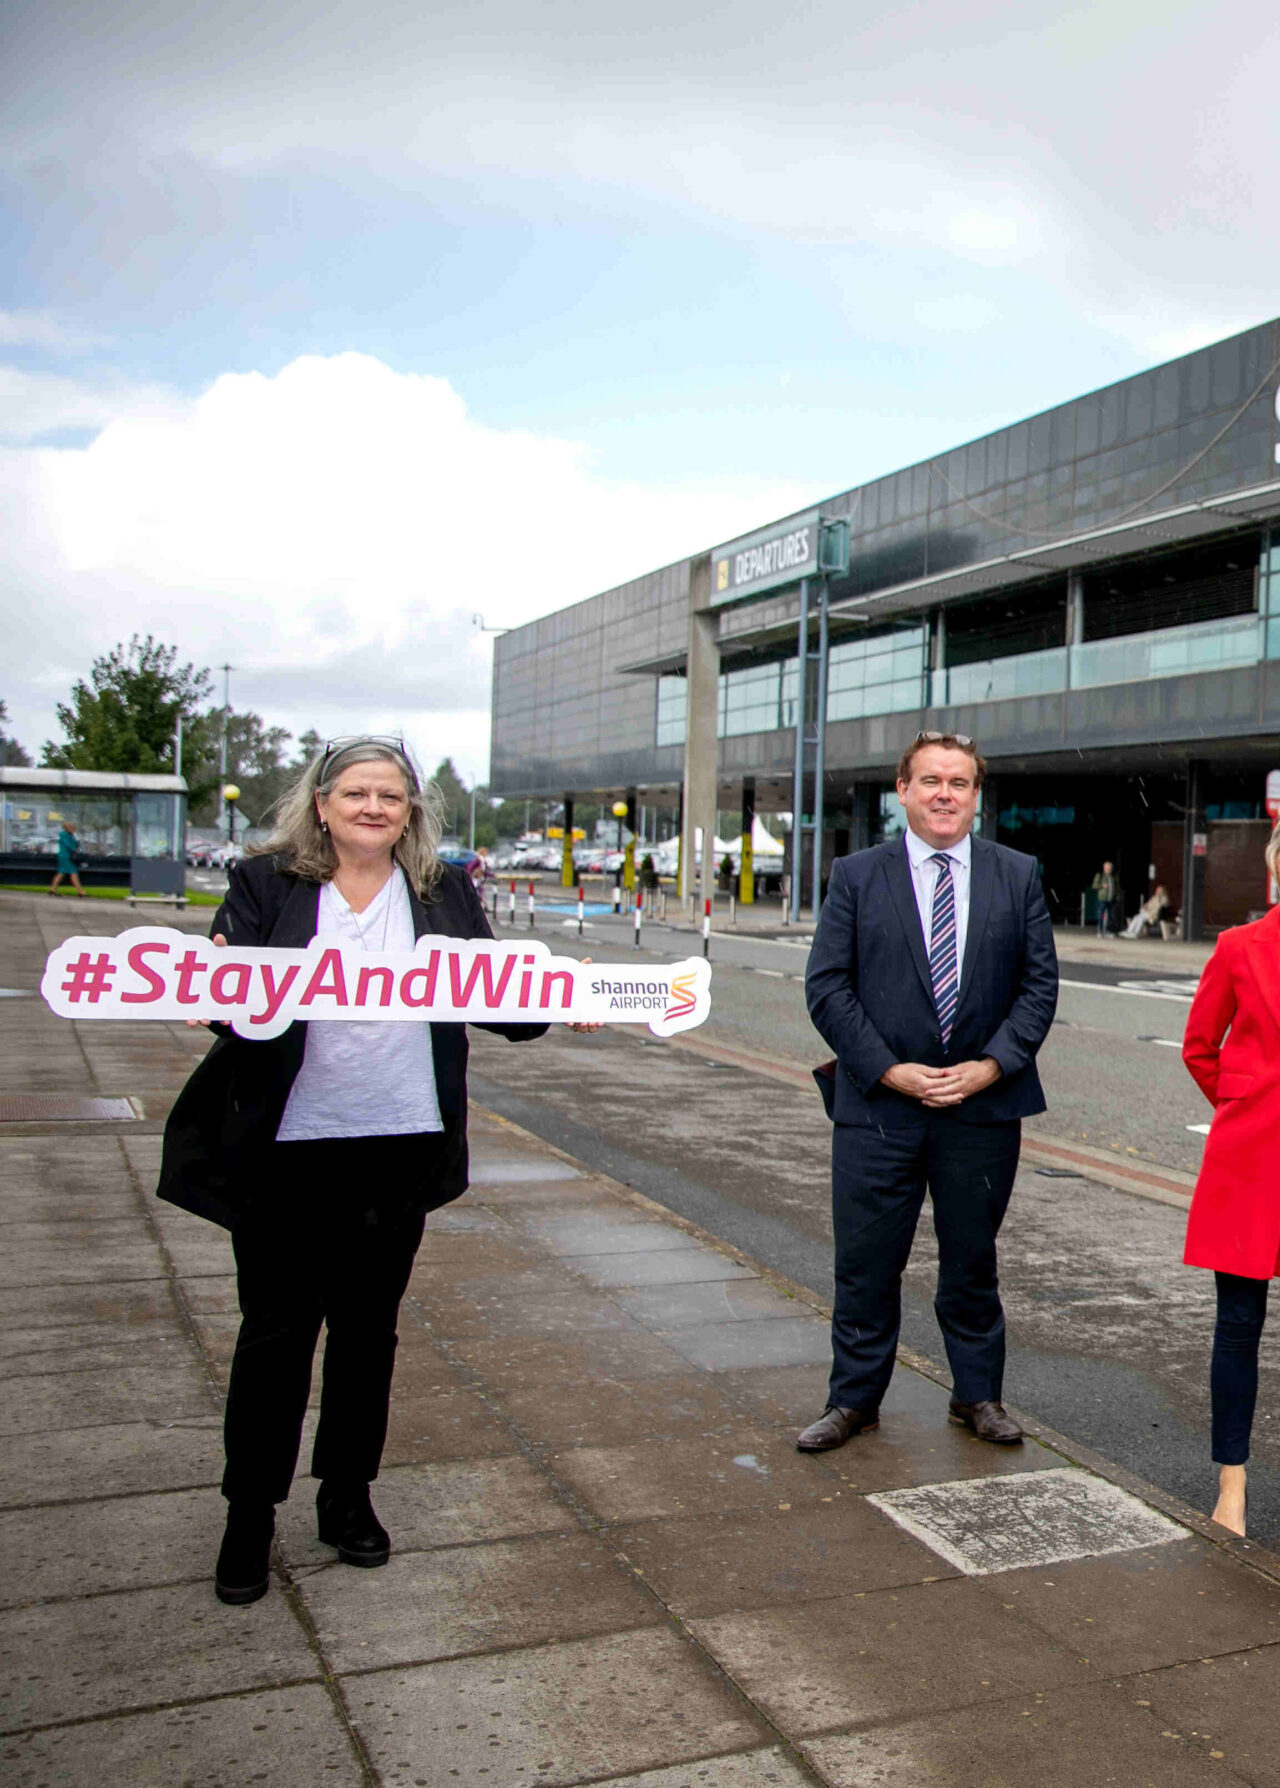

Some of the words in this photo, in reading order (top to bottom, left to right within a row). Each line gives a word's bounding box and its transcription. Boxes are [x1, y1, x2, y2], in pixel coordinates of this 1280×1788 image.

[735, 528, 810, 584] DEPARTURES
[61, 943, 574, 1024] #StayAndWin
[591, 979, 669, 994] shannon
[609, 996, 669, 1009] AIRPORT
